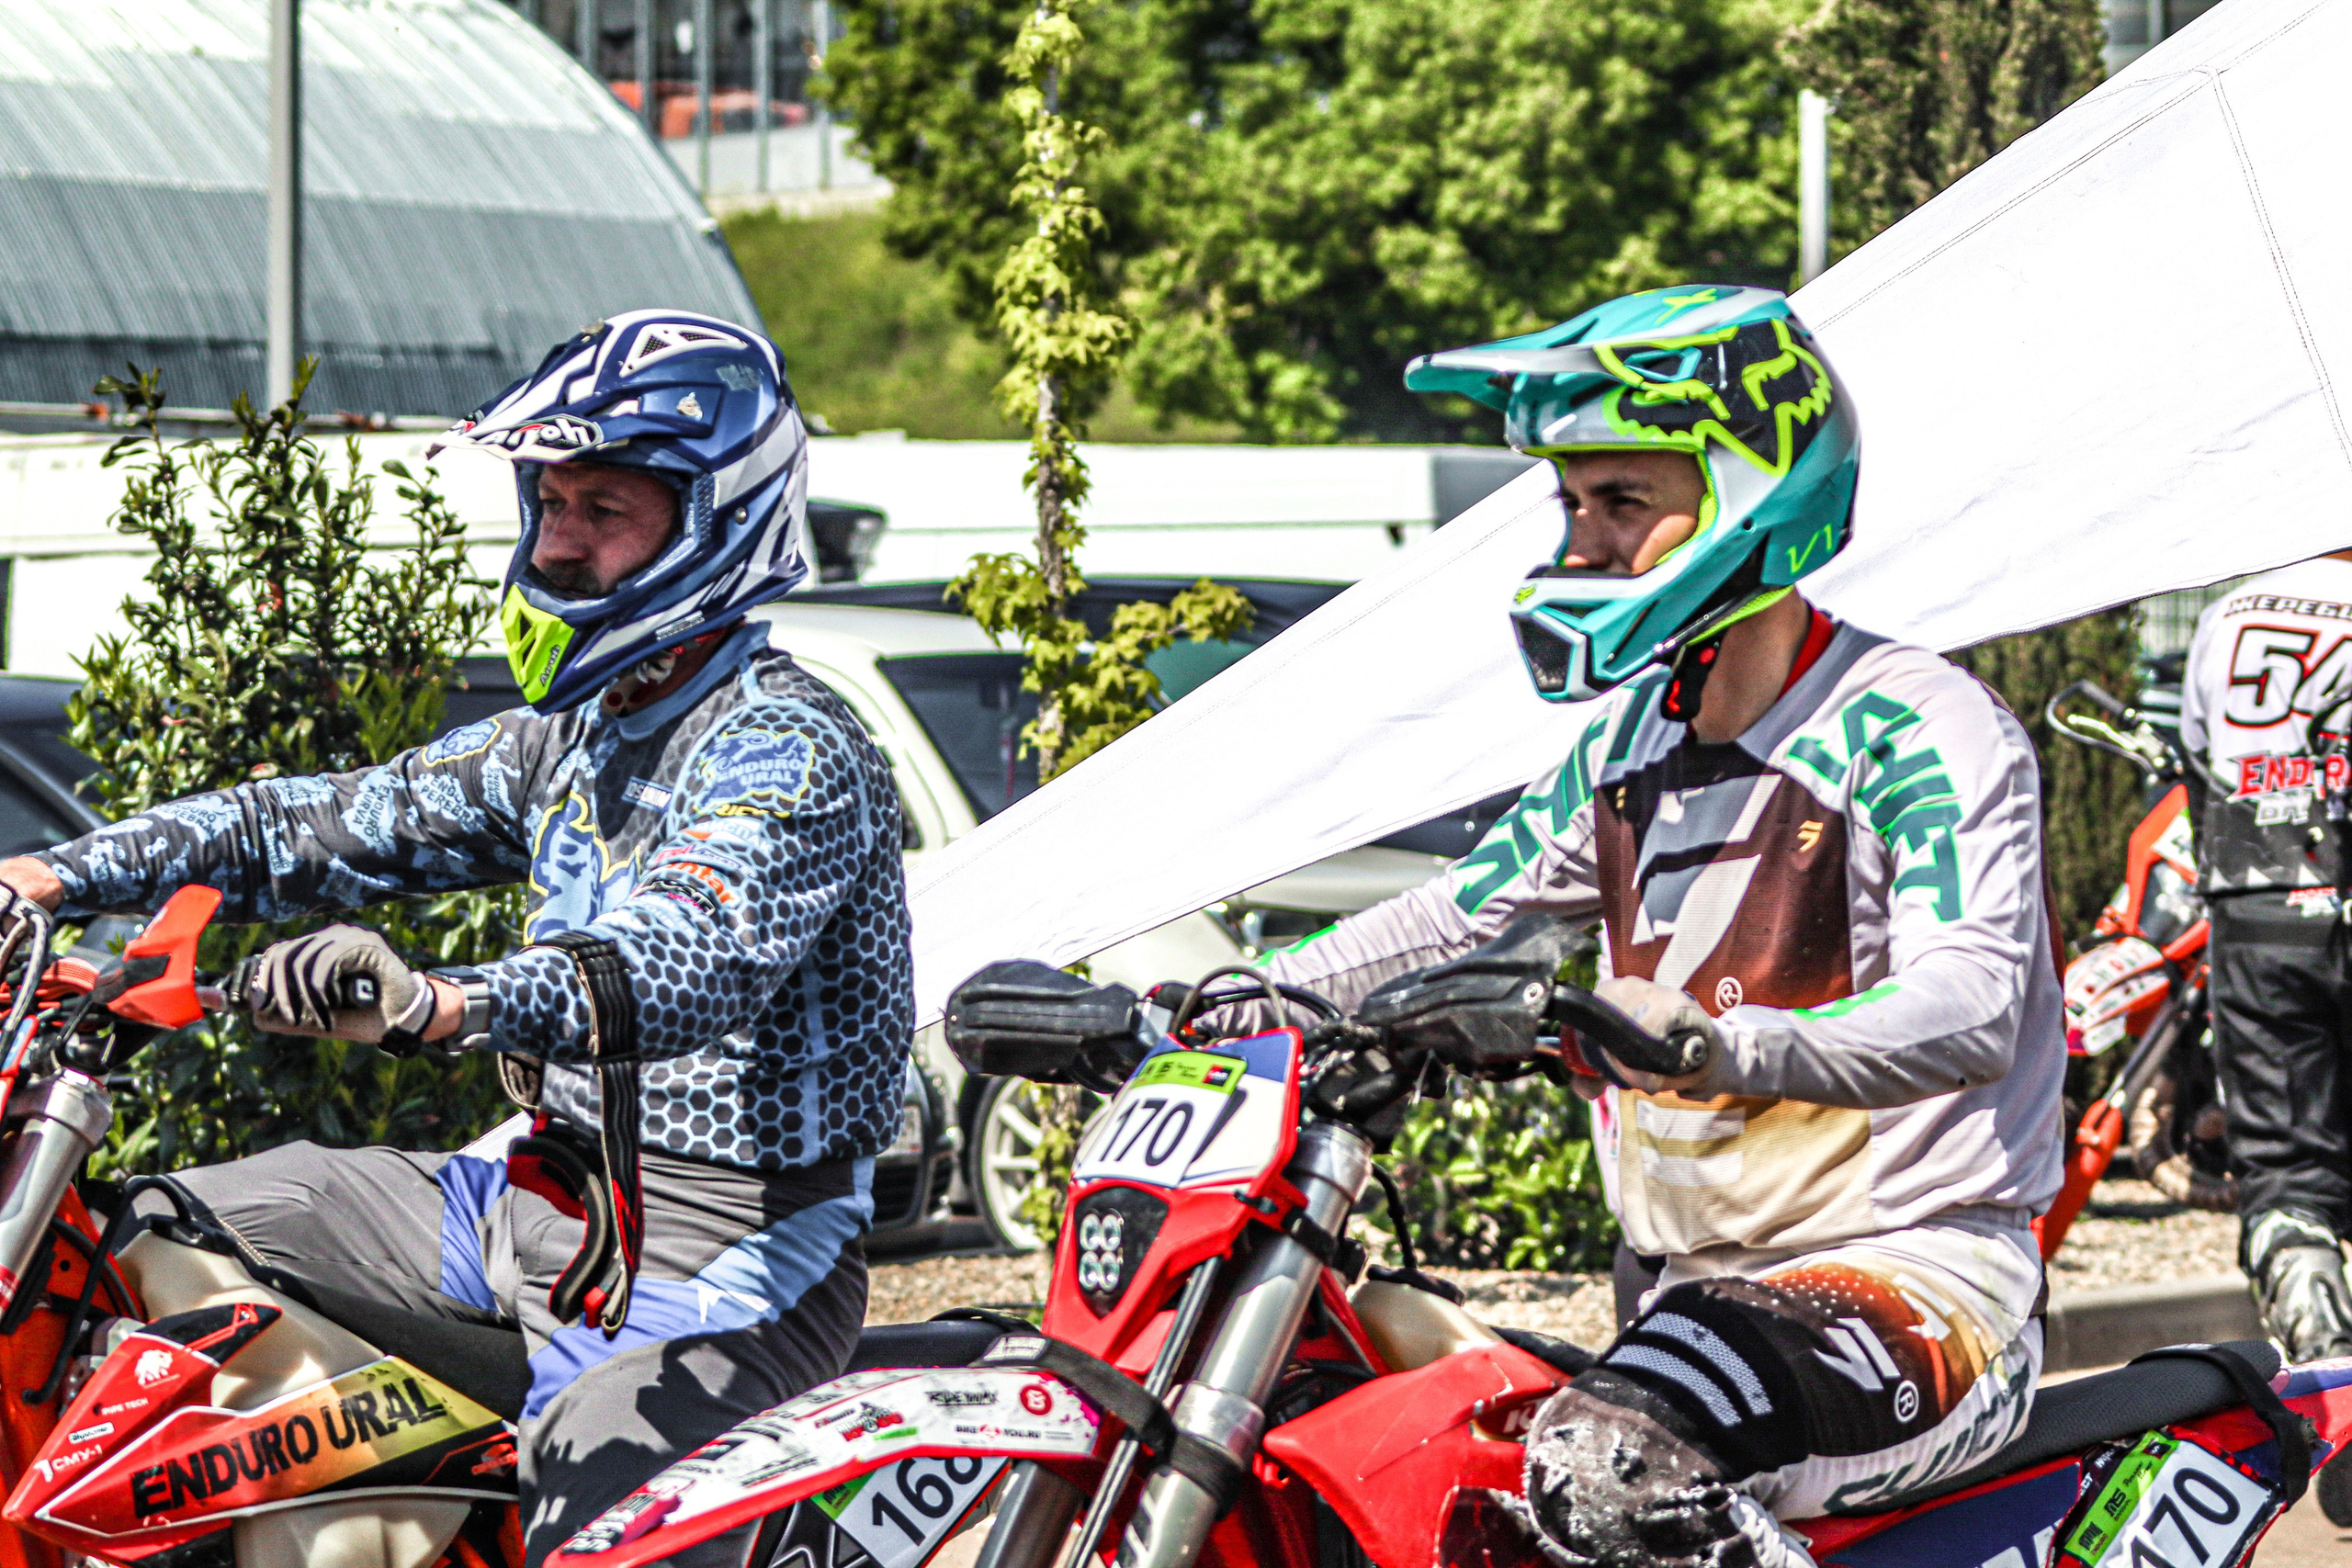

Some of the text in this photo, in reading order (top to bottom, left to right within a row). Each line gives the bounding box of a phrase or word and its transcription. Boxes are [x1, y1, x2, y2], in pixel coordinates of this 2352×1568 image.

[2224, 623, 2352, 729] 54
[717, 758, 802, 783] ENDURO
[740, 770, 796, 787] URAL
[352, 784, 377, 825] KURVA
[364, 784, 390, 837] ENDURO
[1099, 1099, 1194, 1167] 170
[131, 1378, 447, 1518] ENDURO URAL
[872, 1456, 983, 1547] 168
